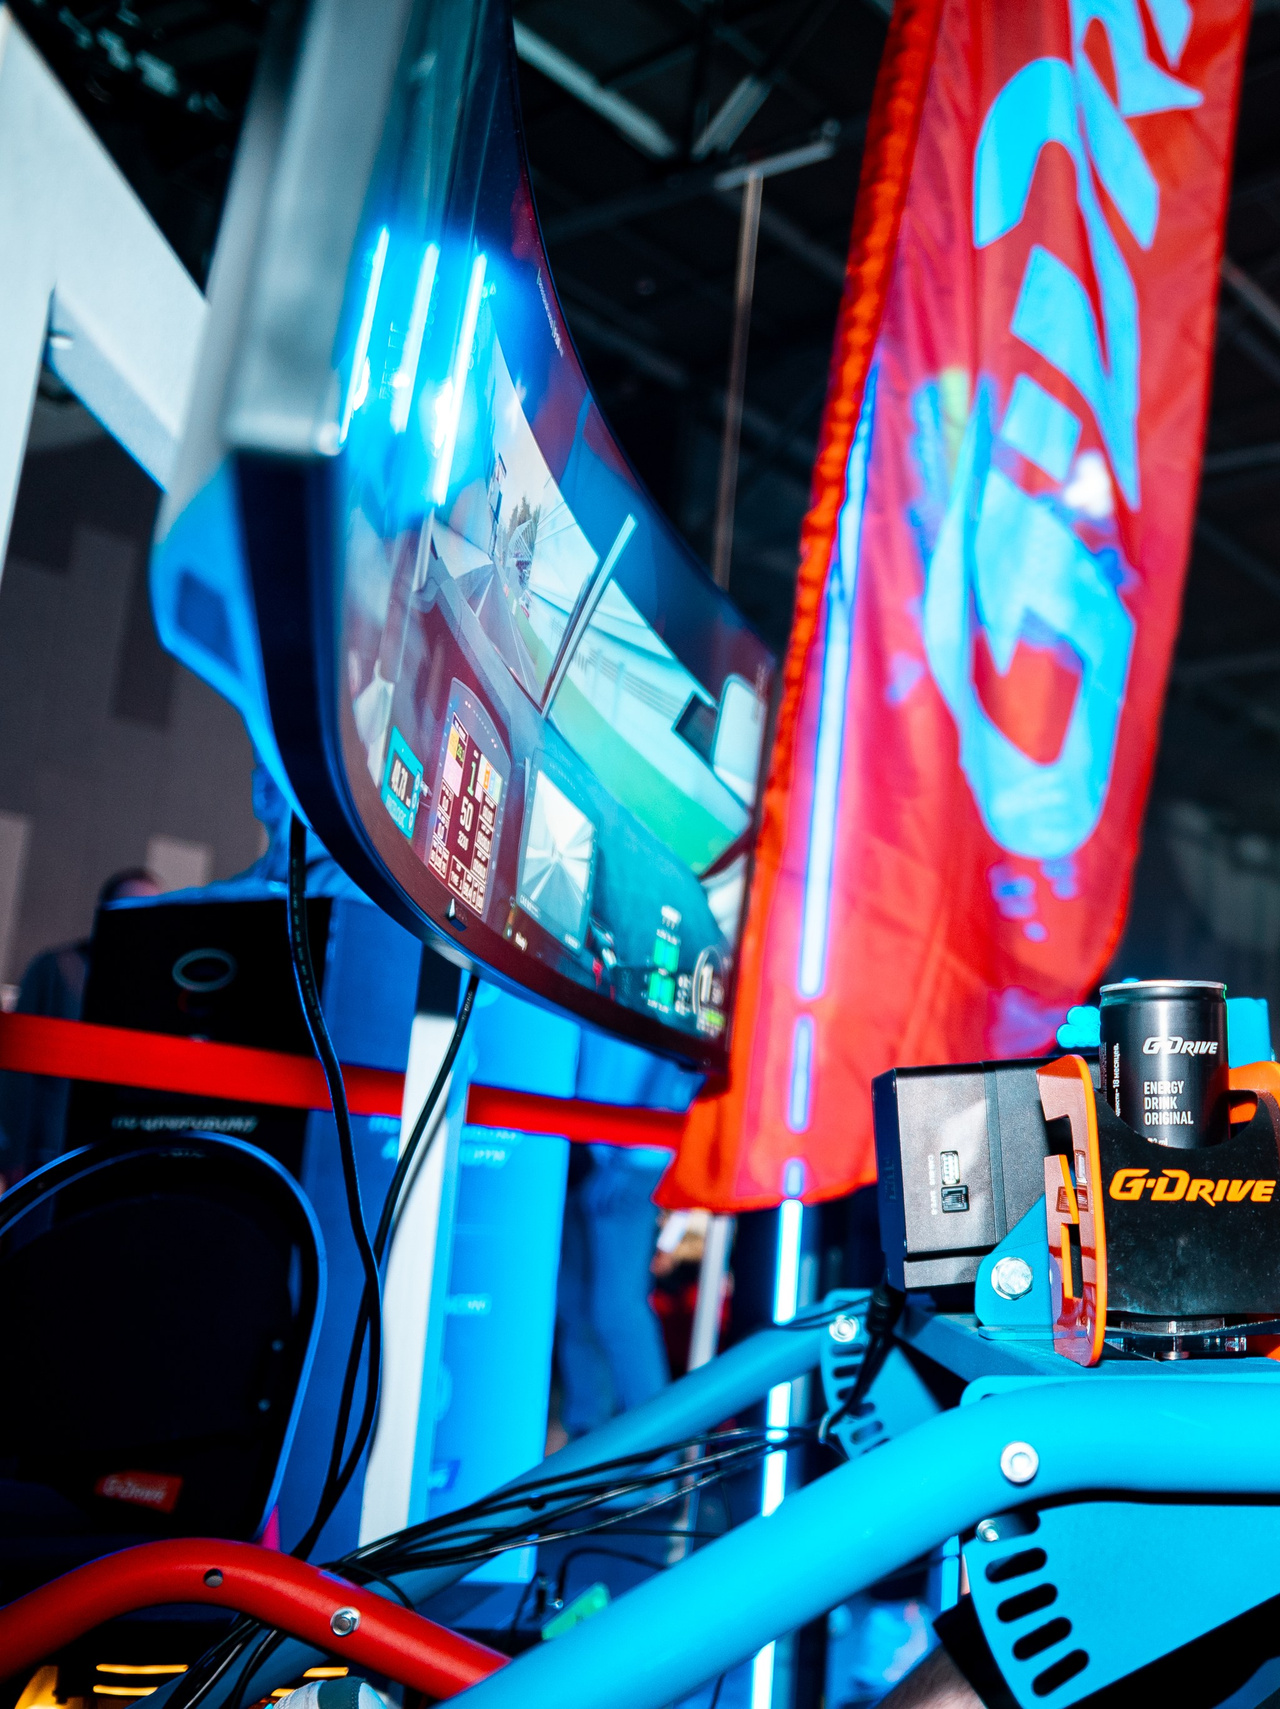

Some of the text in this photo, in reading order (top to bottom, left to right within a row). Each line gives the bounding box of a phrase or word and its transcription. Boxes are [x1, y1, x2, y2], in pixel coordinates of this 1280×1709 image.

[459, 796, 474, 832] 50
[1143, 1080, 1185, 1095] ENERGY
[1144, 1096, 1178, 1110] DRINK
[1144, 1111, 1195, 1126] ORIGINAL
